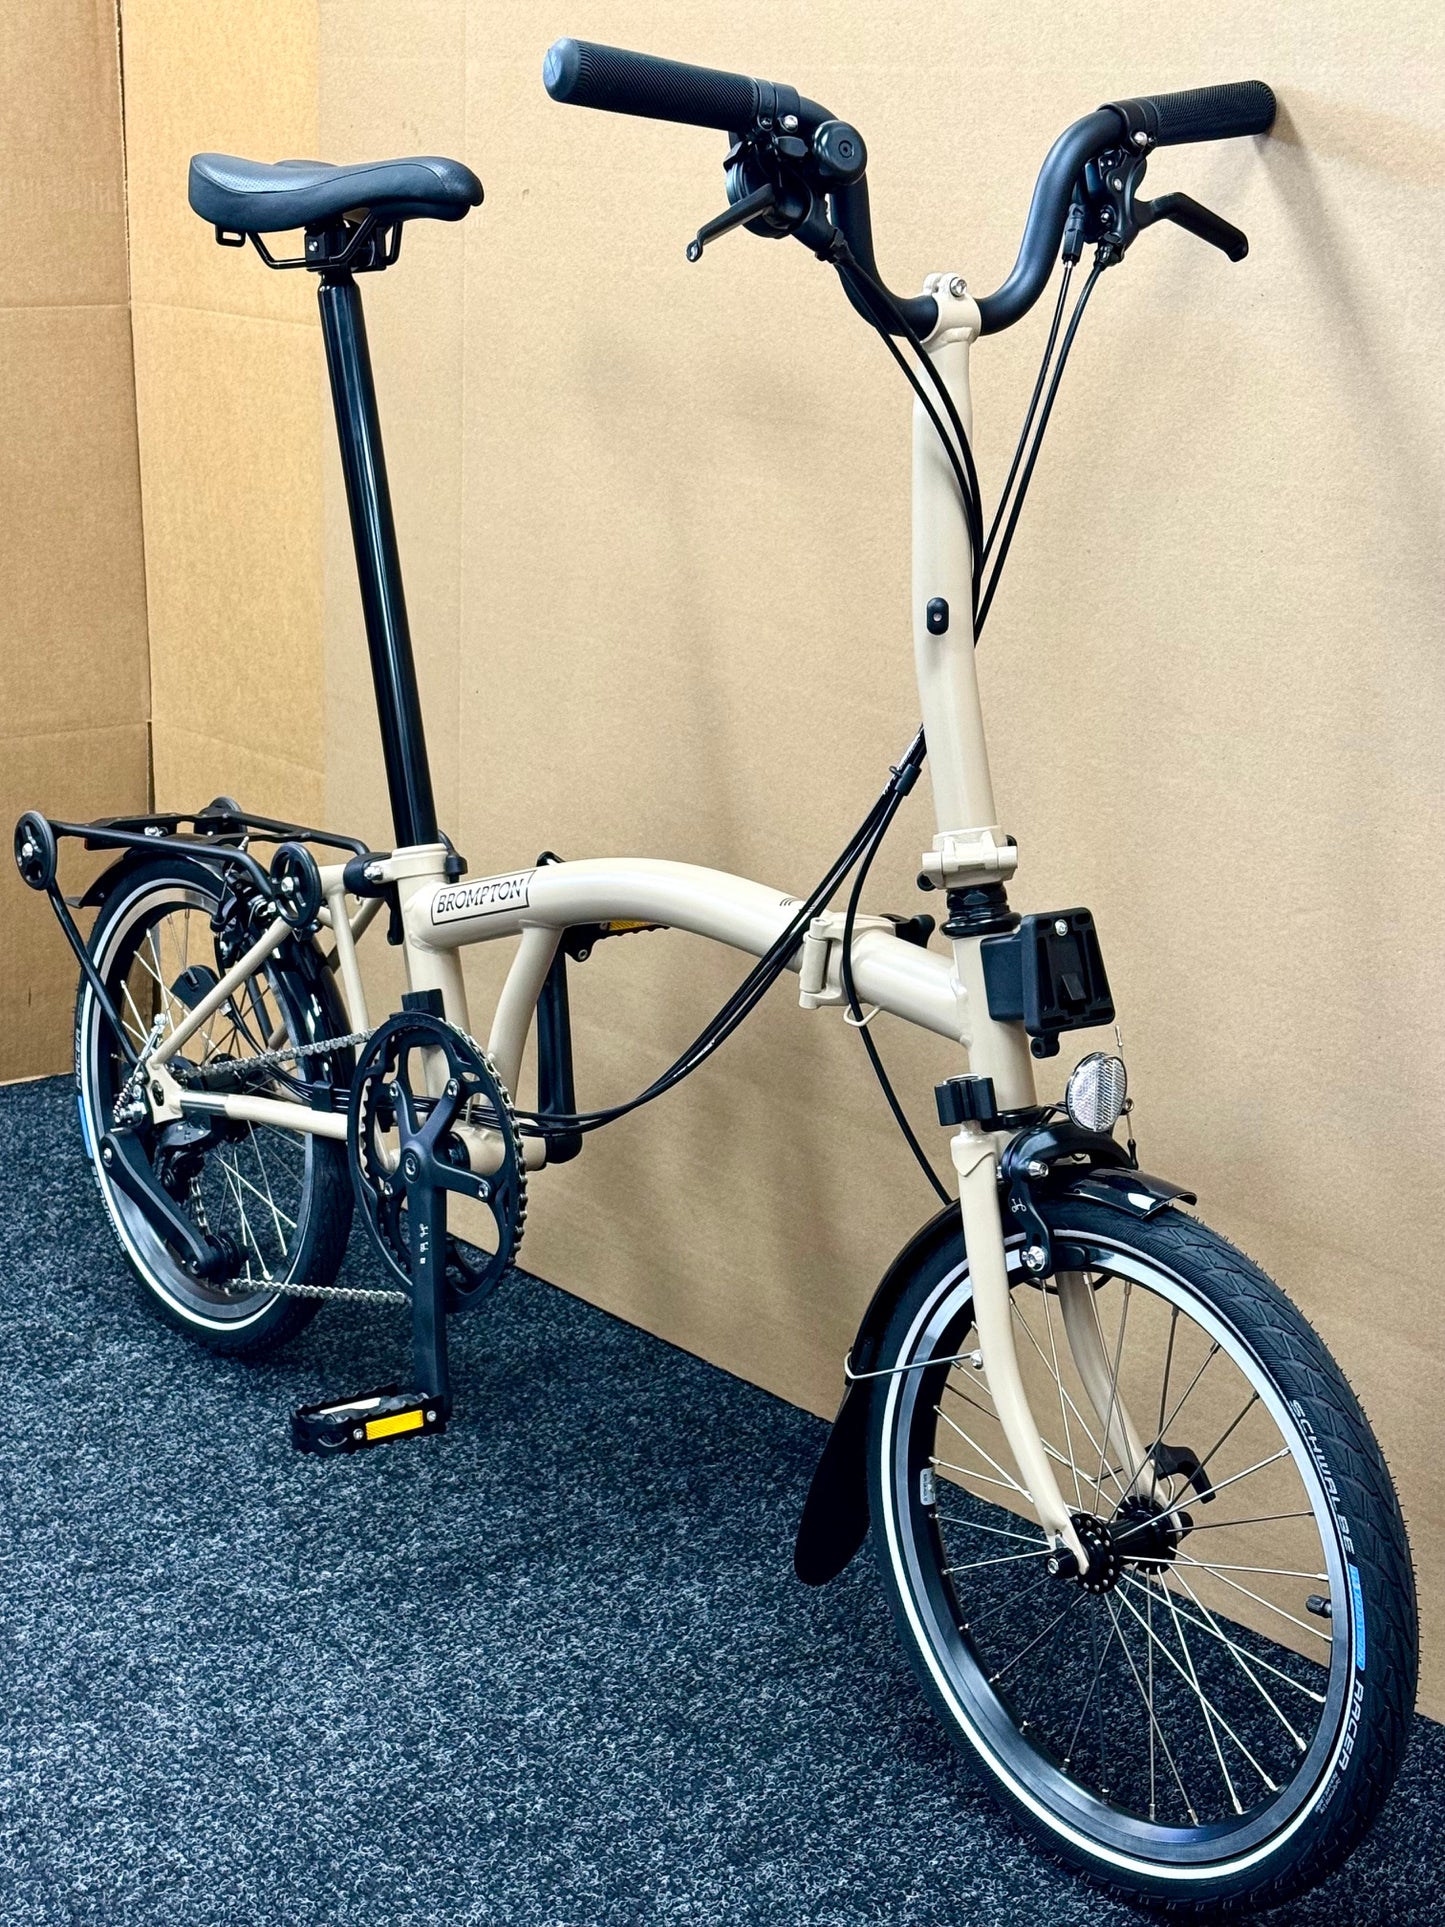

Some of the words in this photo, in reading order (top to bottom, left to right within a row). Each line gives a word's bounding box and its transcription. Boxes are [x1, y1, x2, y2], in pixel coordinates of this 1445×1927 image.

[436, 878, 525, 914] BROMPTON
[1289, 1399, 1355, 1555] SCHWALBE
[1338, 1678, 1365, 1772] RACER
